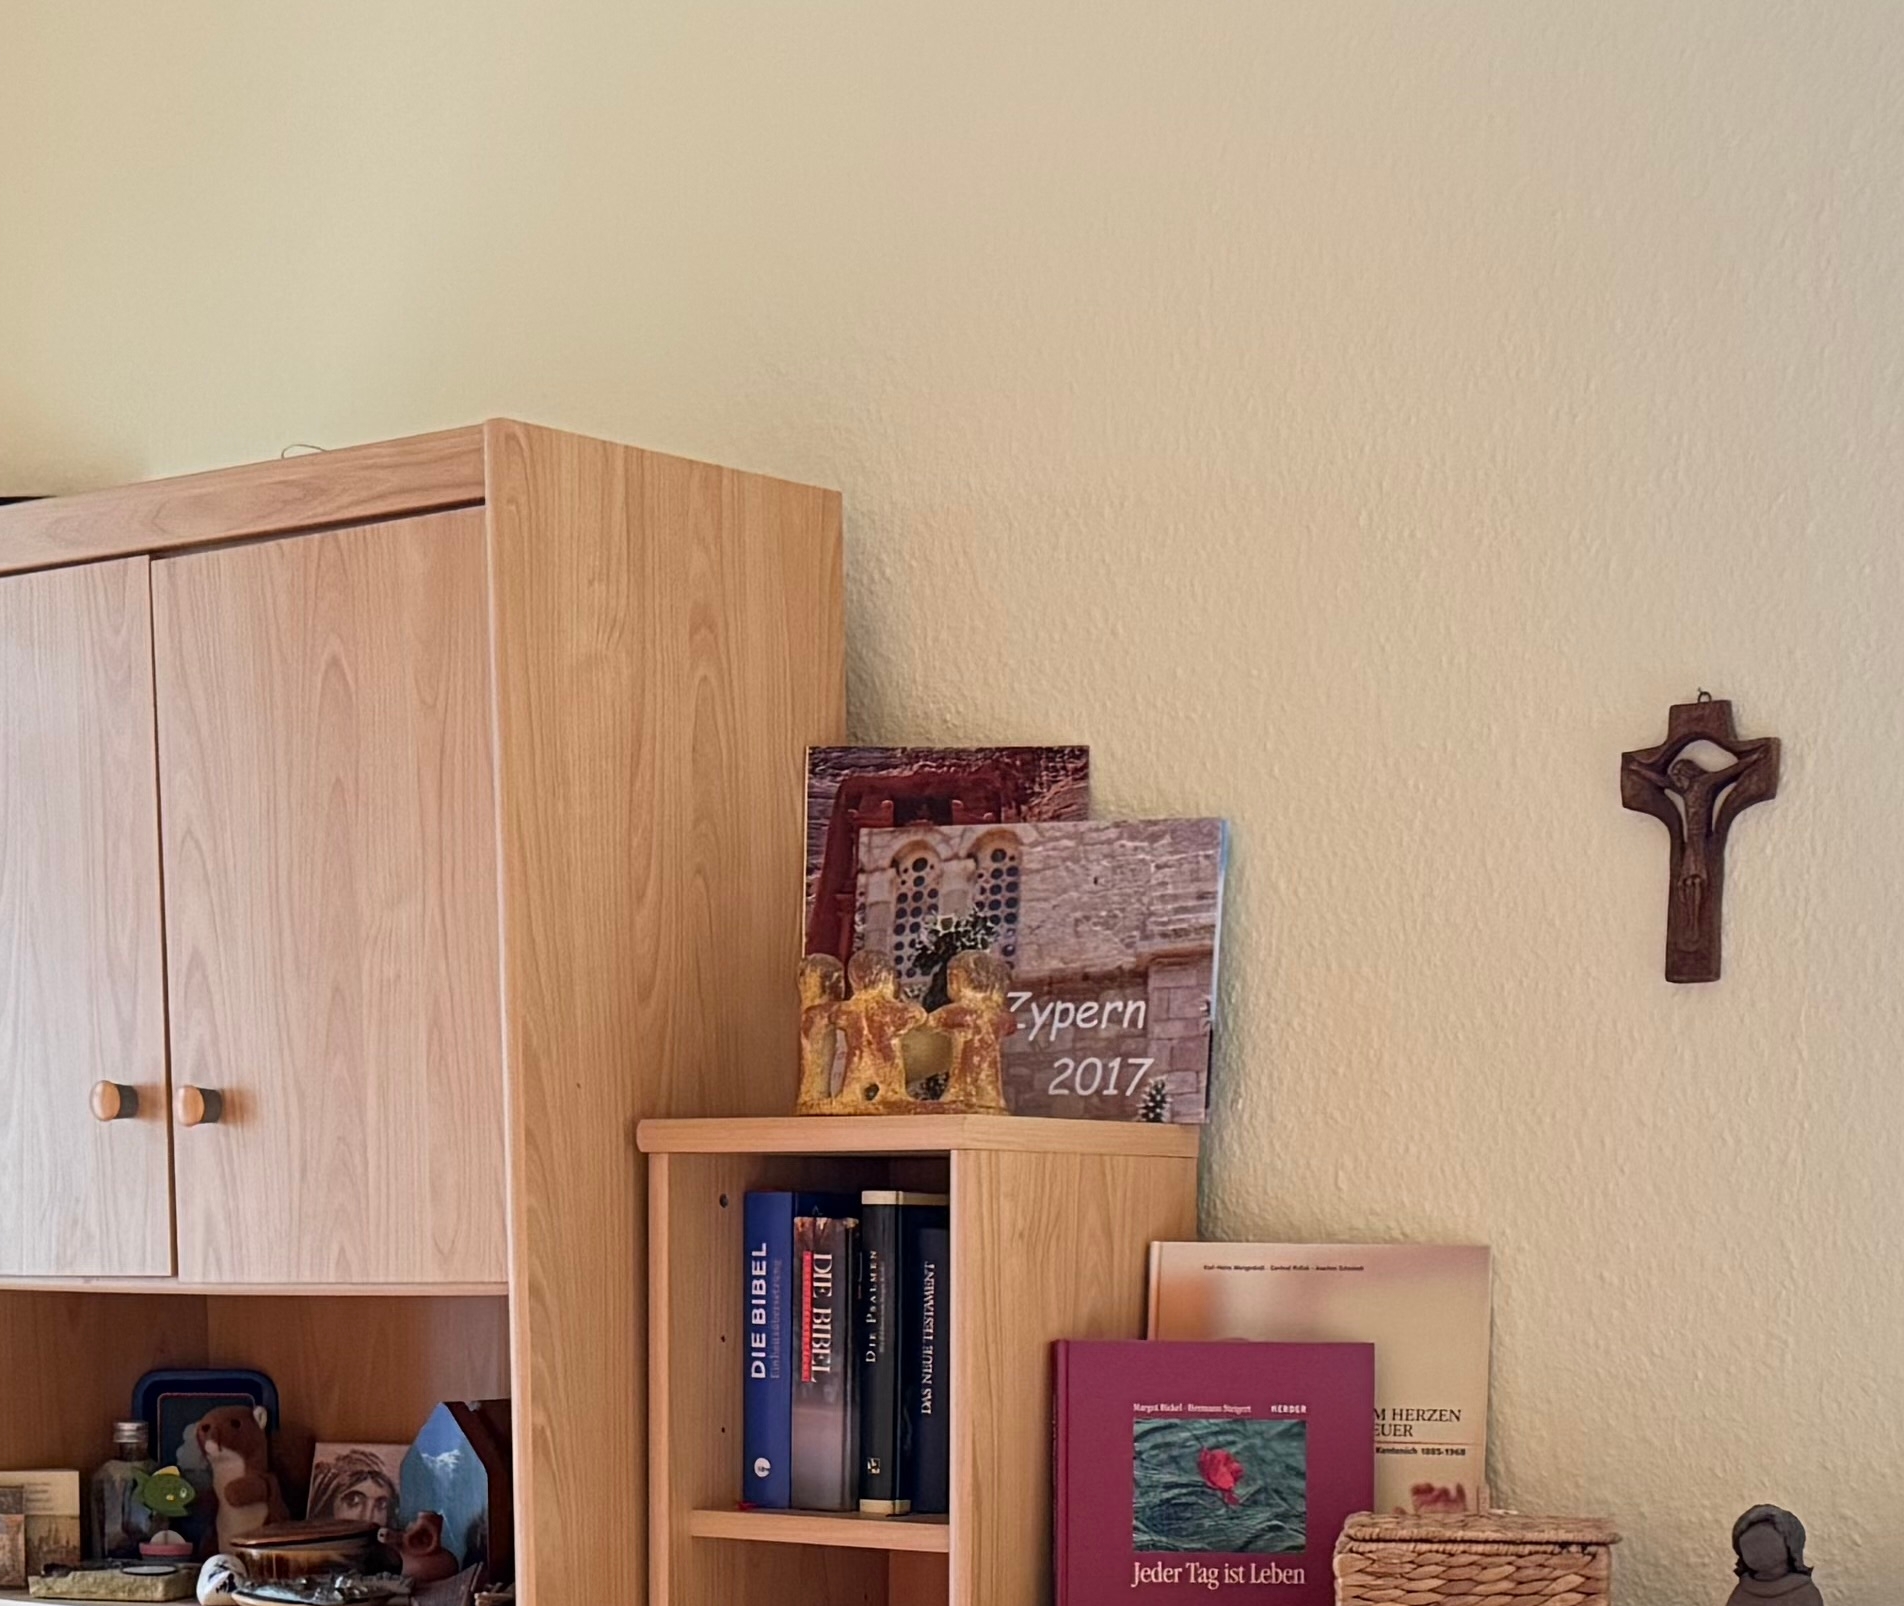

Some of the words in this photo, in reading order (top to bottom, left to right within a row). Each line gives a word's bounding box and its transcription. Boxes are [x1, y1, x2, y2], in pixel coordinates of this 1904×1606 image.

[1005, 992, 1146, 1040] Zypern
[1048, 1057, 1154, 1097] 2017
[751, 1243, 766, 1325] BIBEL
[813, 1253, 833, 1298] DIE
[922, 1262, 935, 1341] TESTAMENT
[751, 1333, 766, 1379] DIE
[811, 1307, 833, 1383] BIBEL
[921, 1346, 934, 1385] NEUE
[921, 1389, 933, 1415] DAS
[1270, 1405, 1307, 1414] HERDER
[1392, 1408, 1462, 1422] HERZEN
[1375, 1423, 1414, 1438] EUER
[1130, 1561, 1183, 1588] Jeder
[1185, 1562, 1221, 1590] Tag
[1223, 1563, 1246, 1584] ist
[1249, 1562, 1306, 1585] Leben
